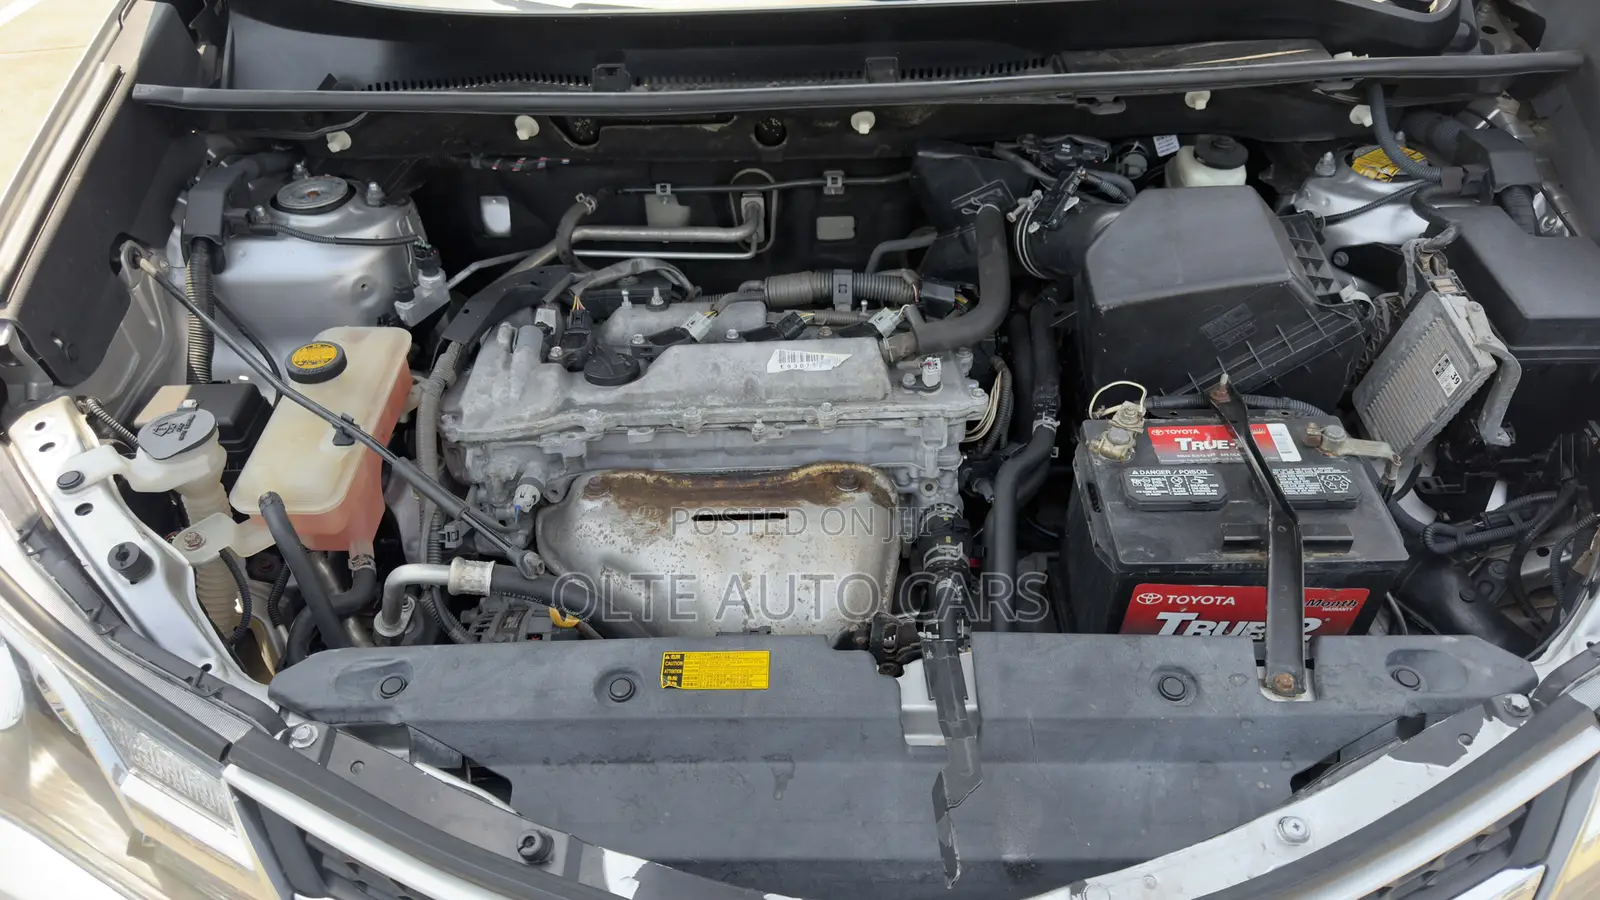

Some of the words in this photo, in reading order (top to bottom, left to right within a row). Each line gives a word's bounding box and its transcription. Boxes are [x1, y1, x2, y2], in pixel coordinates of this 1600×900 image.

[1450, 371, 1461, 385] 39
[1174, 437, 1239, 451] TRUE-
[1166, 594, 1236, 606] TOYOTA
[1305, 599, 1358, 608] Month
